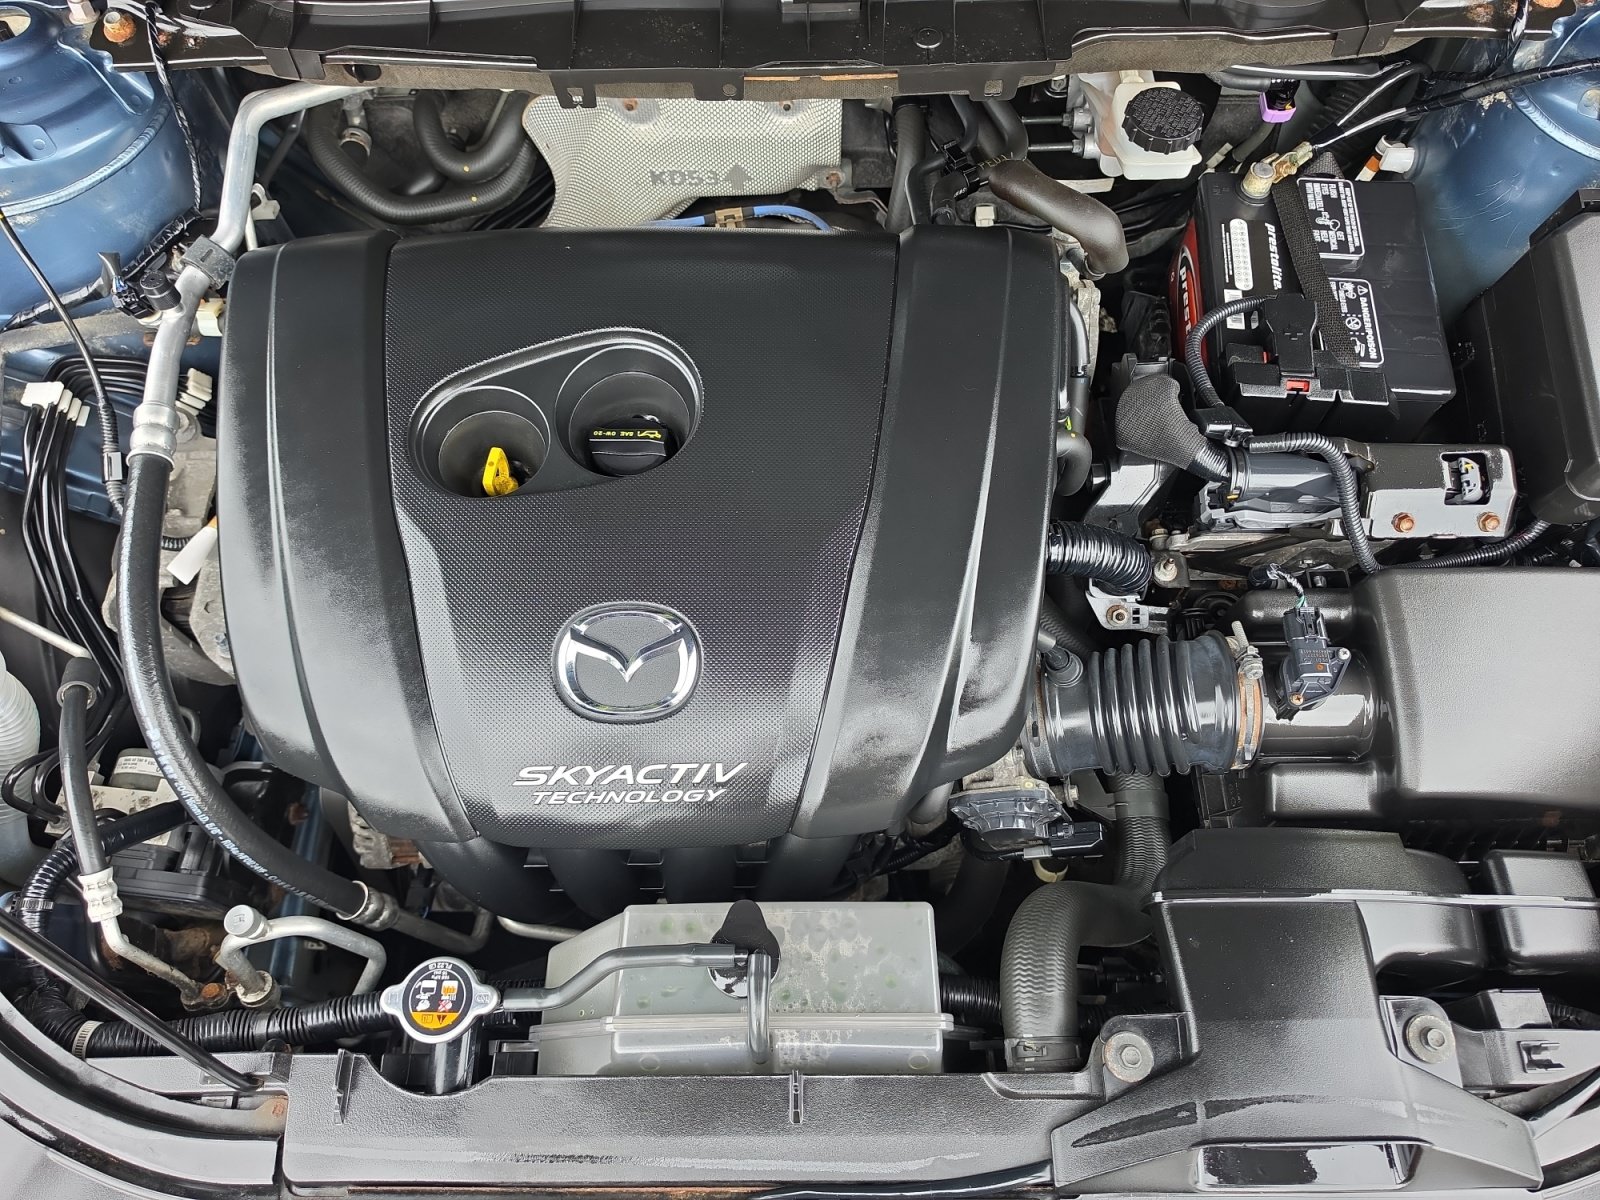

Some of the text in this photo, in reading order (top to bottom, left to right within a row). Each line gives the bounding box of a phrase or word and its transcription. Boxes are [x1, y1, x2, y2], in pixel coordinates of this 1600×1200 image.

[1179, 266, 1193, 339] prest
[1359, 297, 1378, 359] DANGER/POISON
[512, 761, 748, 787] SKYACTIV
[531, 787, 728, 805] TECHNOLOGY
